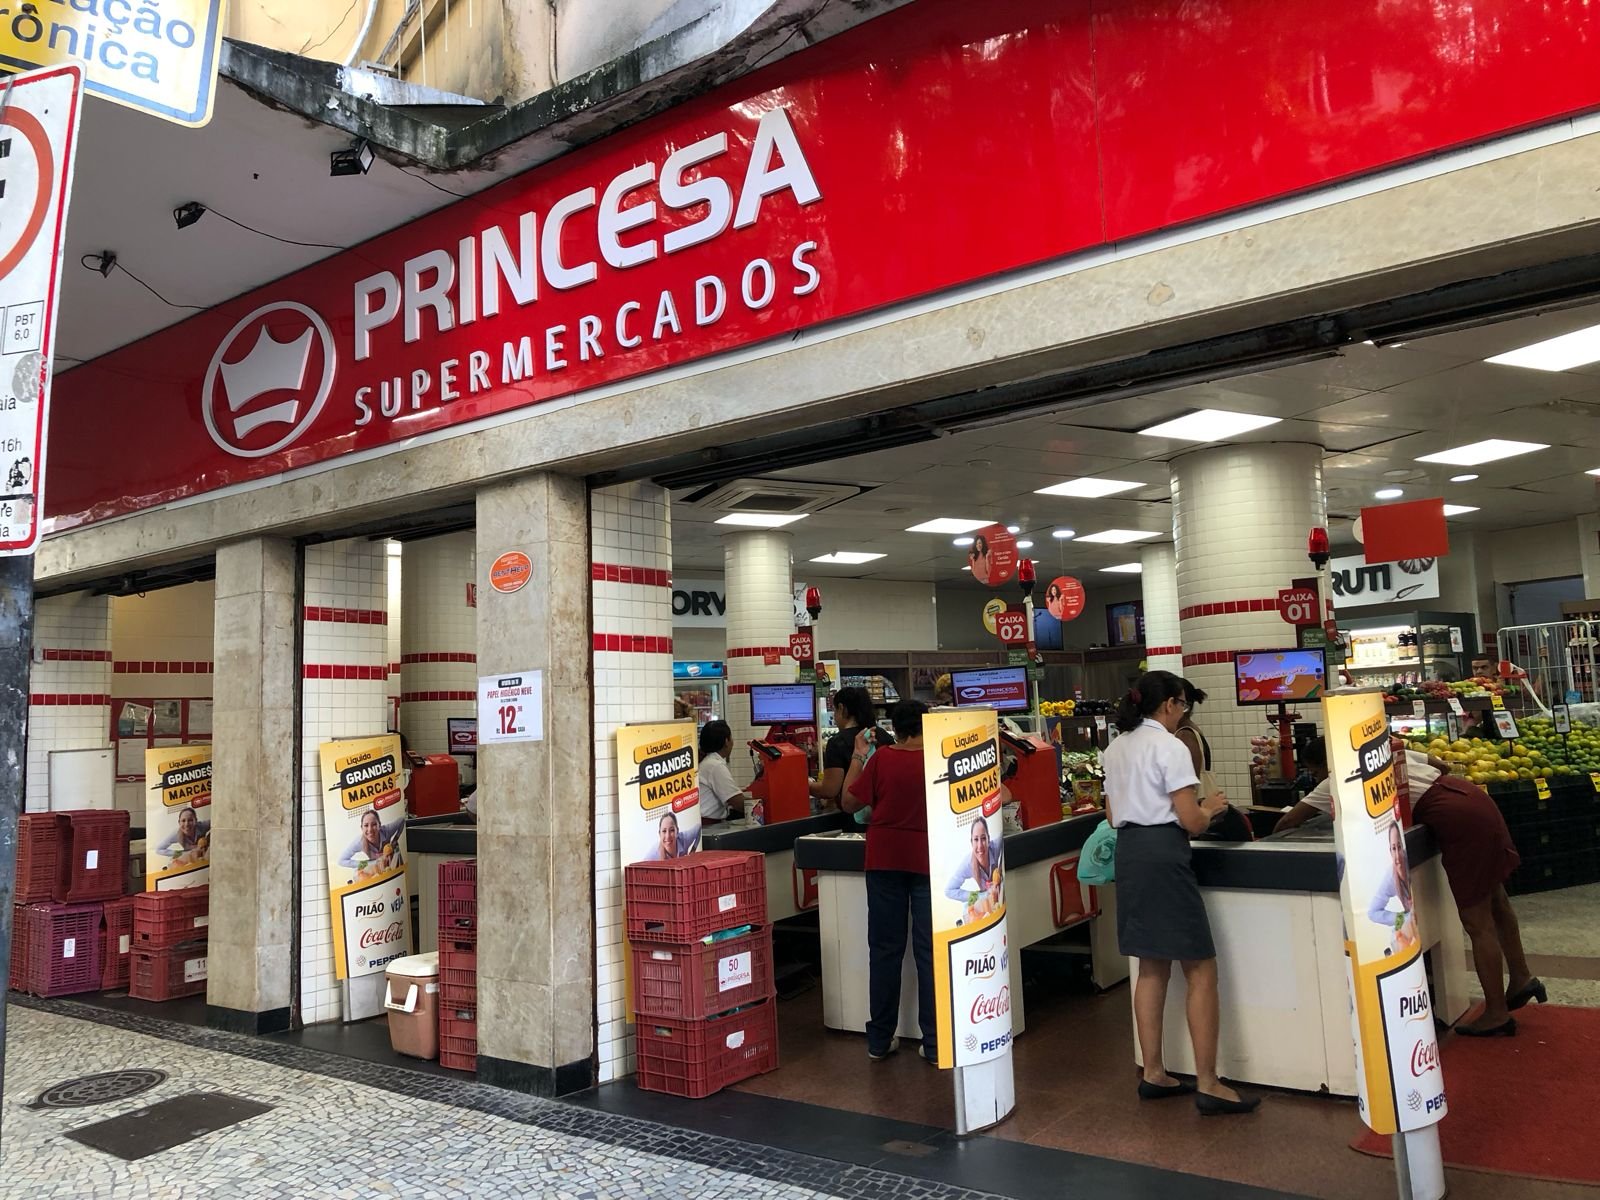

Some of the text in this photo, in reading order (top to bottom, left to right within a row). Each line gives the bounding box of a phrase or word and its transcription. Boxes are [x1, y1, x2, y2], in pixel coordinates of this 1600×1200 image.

[57, 0, 195, 48] ação
[354, 107, 823, 361] PRINCESA
[15, 313, 36, 326] PBT
[354, 240, 821, 426] SUPERMERCADOS
[1282, 593, 1314, 602] CAIXA
[998, 616, 1024, 624] CAIXA
[1287, 603, 1311, 620] 01
[1000, 624, 1025, 640] 02
[792, 644, 811, 658] 03
[498, 705, 517, 734] 12
[646, 742, 672, 755] Liquida
[954, 733, 979, 748] Liquida
[169, 759, 192, 769] Liquida
[346, 753, 372, 765] Liquida
[645, 751, 692, 779] GRANDE$
[953, 744, 996, 777] GRANDE$
[345, 759, 393, 785] GRANDE$
[348, 777, 394, 803] MARCA$
[647, 773, 693, 802] MARCA$
[956, 770, 998, 804] MARCA$
[355, 902, 384, 917] PILÃO
[728, 958, 739, 972] 50
[965, 954, 996, 976] PILÃO
[1399, 990, 1428, 1018] PILÃO
